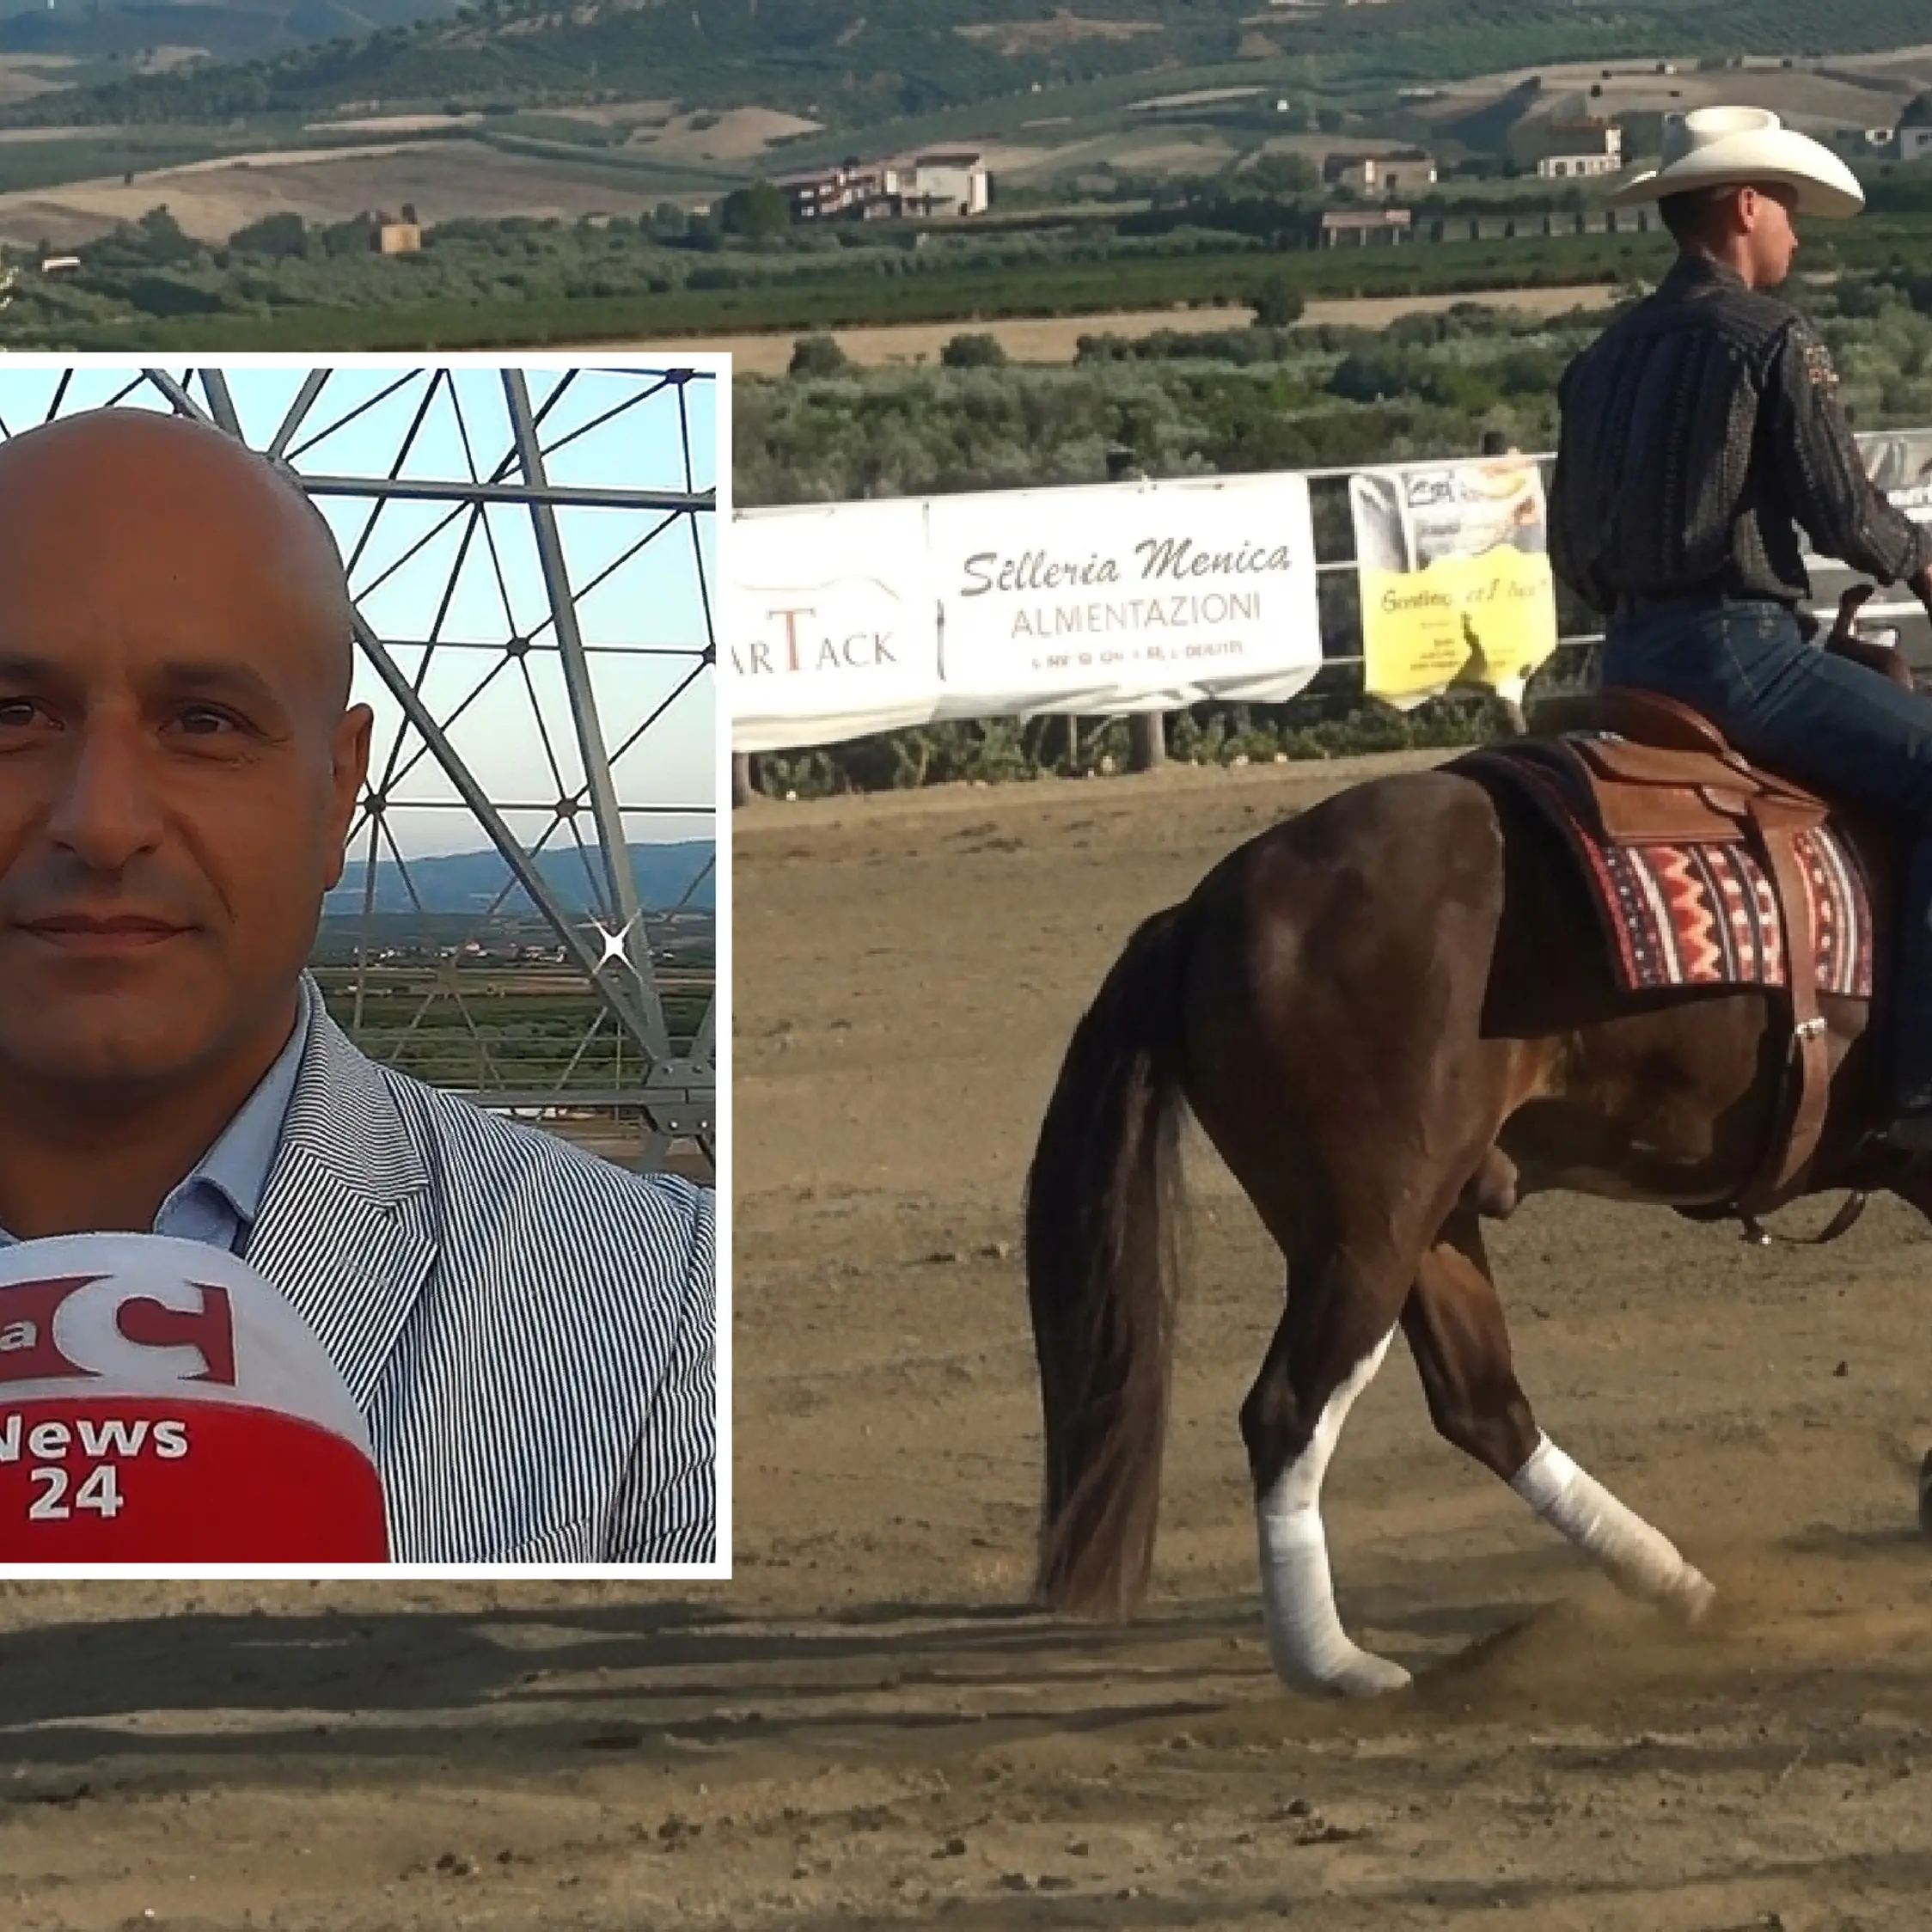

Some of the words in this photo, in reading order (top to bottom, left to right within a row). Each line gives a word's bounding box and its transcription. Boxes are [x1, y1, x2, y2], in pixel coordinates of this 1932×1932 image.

[1134, 537, 1291, 579] Menica
[0, 1415, 188, 1462] News
[28, 1464, 124, 1520] 24
